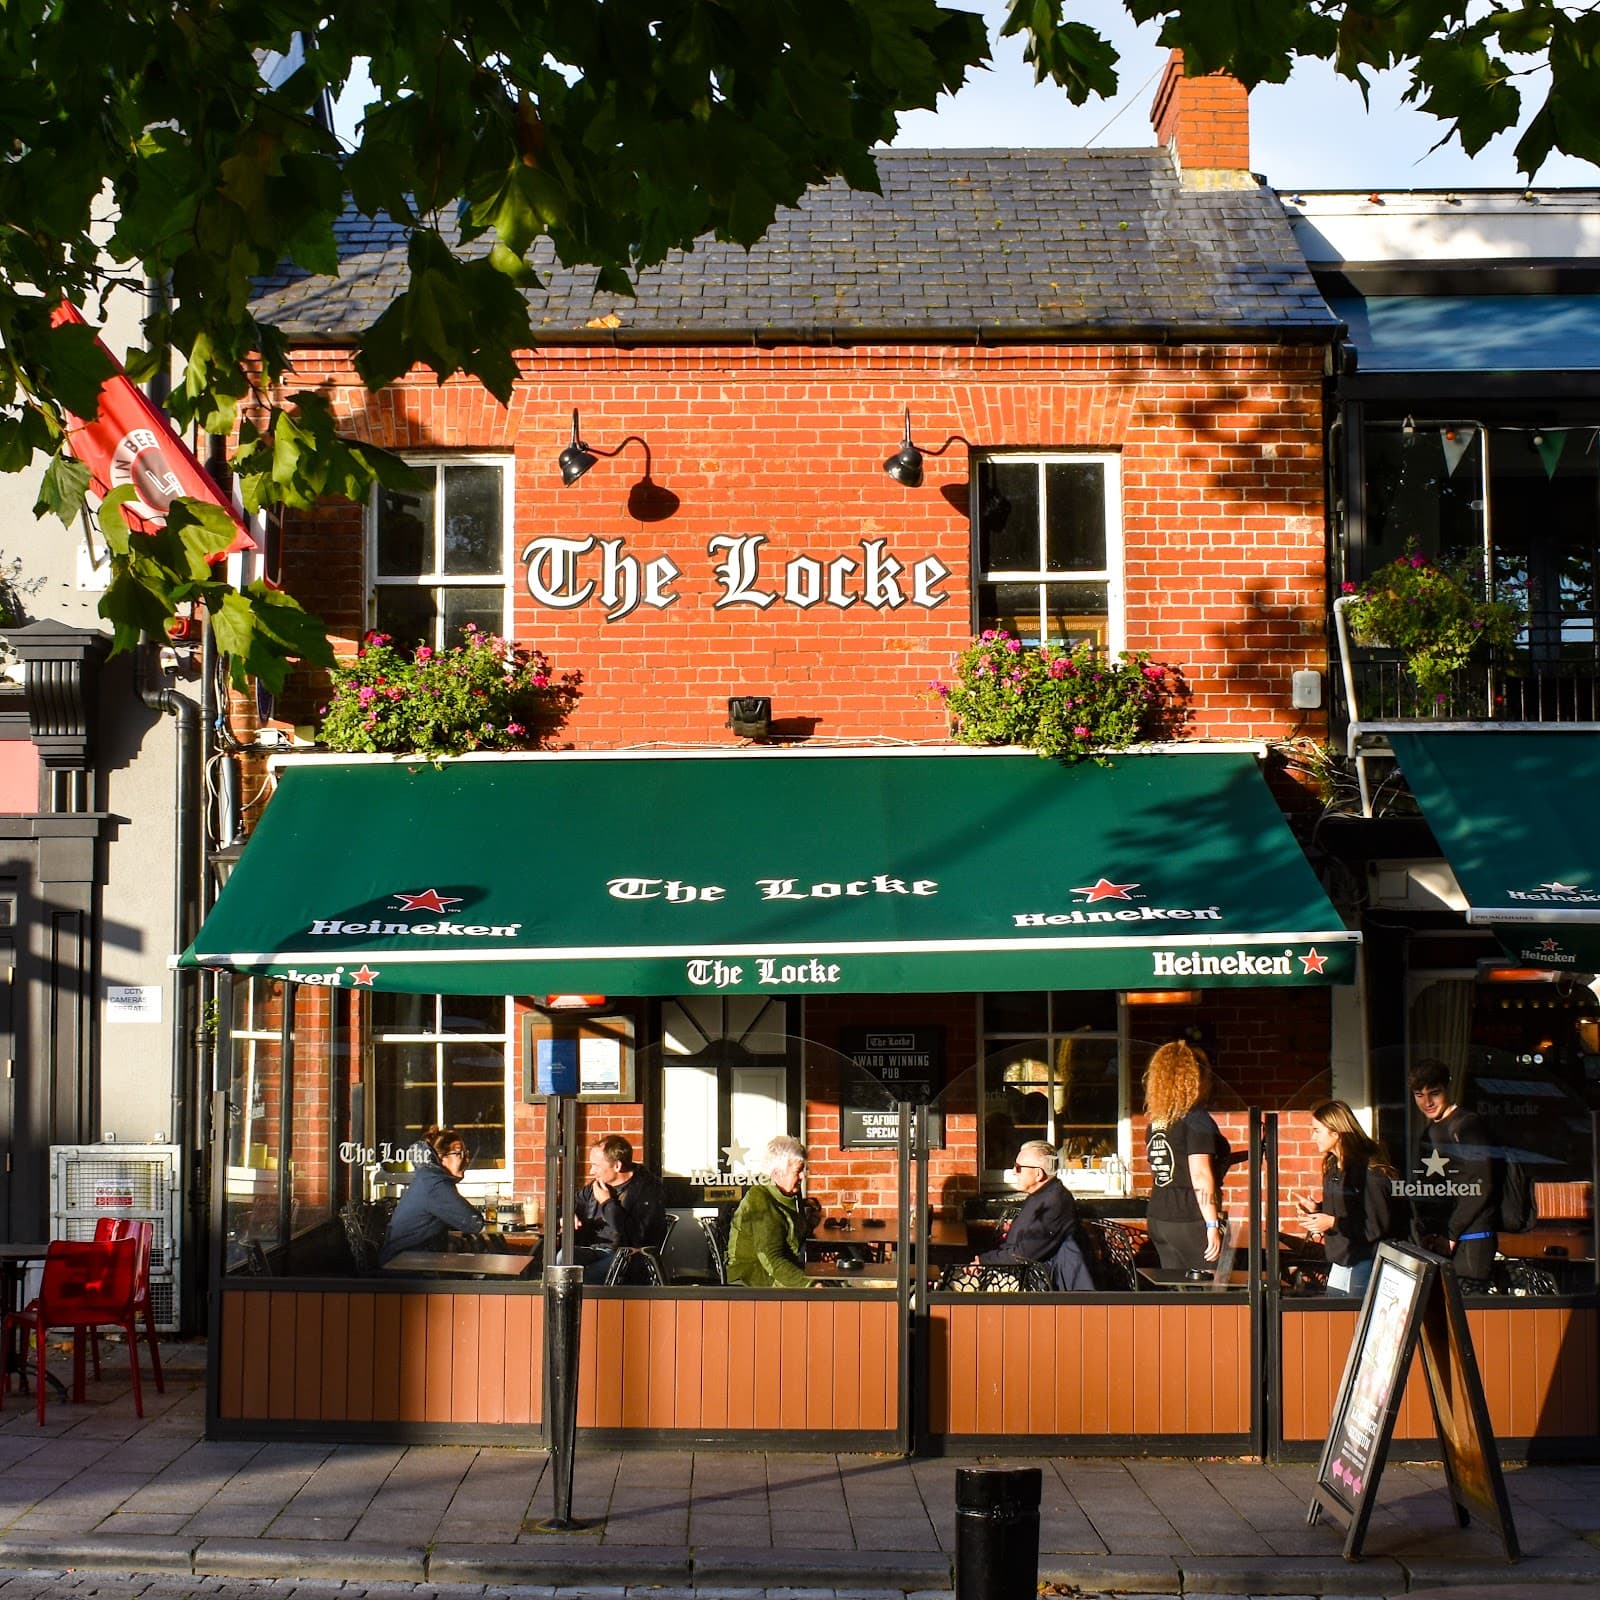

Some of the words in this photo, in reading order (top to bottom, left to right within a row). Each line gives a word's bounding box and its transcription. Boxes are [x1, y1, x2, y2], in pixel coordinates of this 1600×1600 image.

[520, 533, 683, 623] The
[706, 533, 952, 611] Locke
[606, 878, 727, 904] The
[755, 874, 939, 901] Locke
[686, 958, 743, 989] The
[755, 957, 841, 985] Locke
[851, 1055, 884, 1067] AWARD
[889, 1055, 929, 1067] WINNING
[882, 1068, 900, 1079] PUB
[339, 1141, 375, 1166] The
[379, 1141, 432, 1164] Locke
